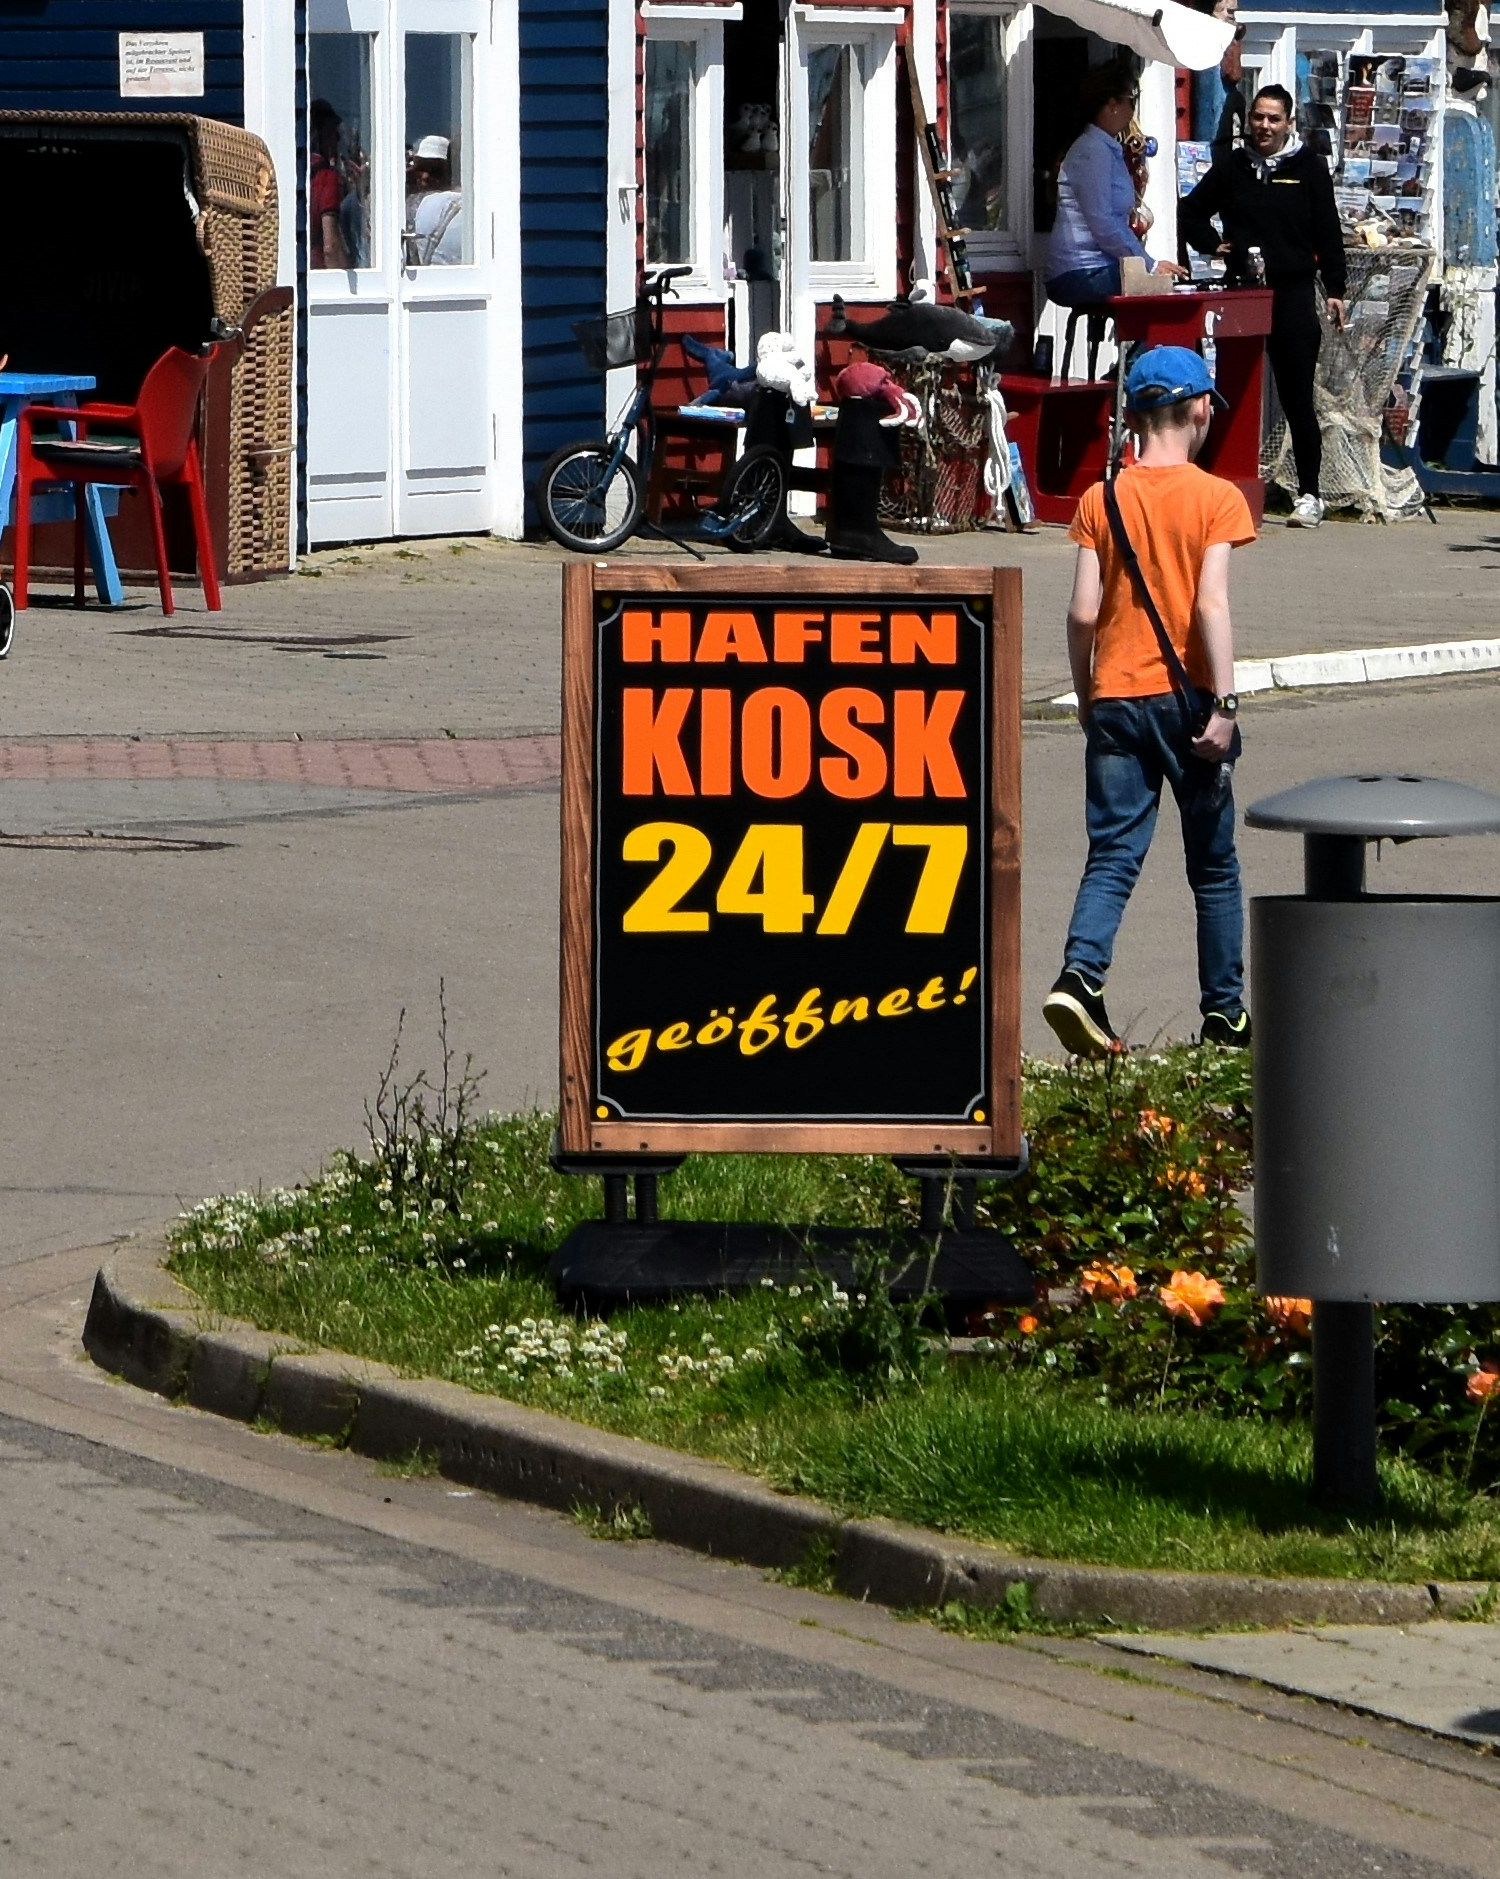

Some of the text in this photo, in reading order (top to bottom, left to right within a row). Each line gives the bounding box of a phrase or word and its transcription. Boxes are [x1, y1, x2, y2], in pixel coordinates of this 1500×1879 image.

[622, 612, 957, 665] HAFEN
[622, 686, 967, 799] KIOSK
[622, 821, 968, 934] 24/7
[605, 966, 978, 1072] geöffnet!
